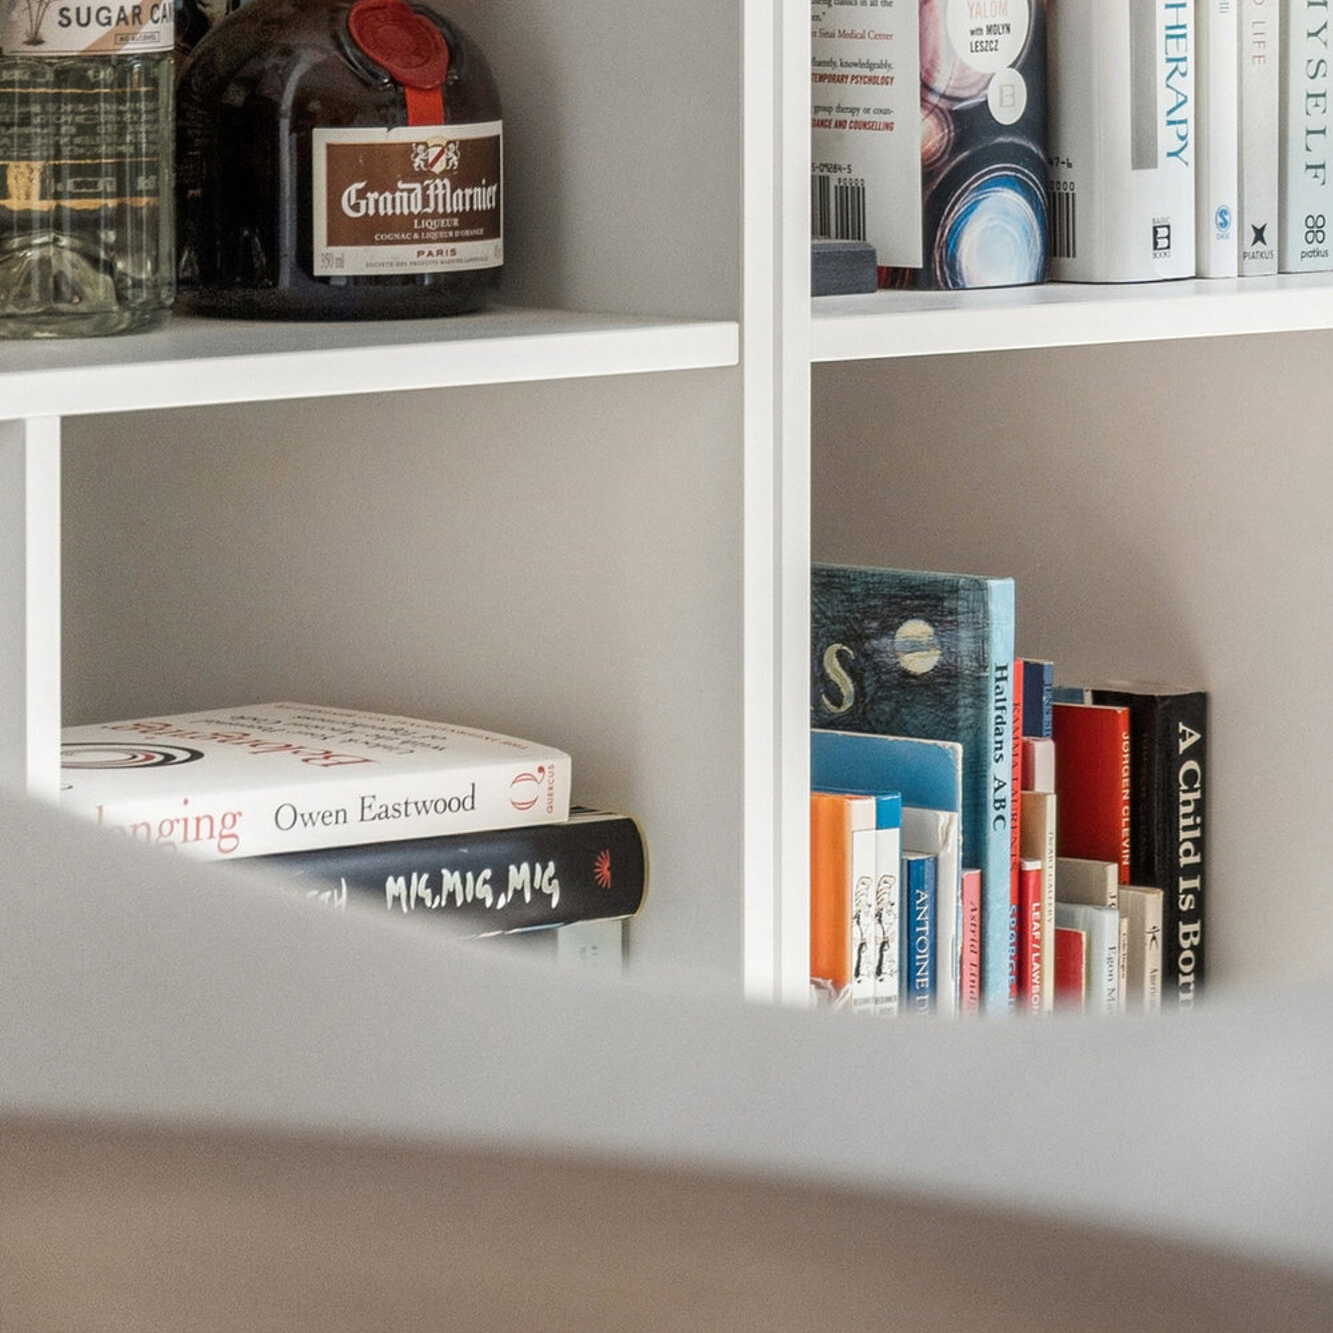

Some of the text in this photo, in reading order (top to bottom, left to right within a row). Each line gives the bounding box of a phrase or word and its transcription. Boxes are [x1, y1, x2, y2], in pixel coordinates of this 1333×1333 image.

[57, 4, 144, 29] SUGAR
[966, 0, 1009, 21] YALOM
[837, 29, 894, 42] Medical Center
[969, 39, 1001, 54] LESZCZ
[1250, 20, 1267, 66] LIFE
[850, 72, 895, 86] PSYCHOLOGY
[848, 119, 895, 133] COUNSELLING
[340, 176, 499, 218] Grand Marnier
[374, 229, 454, 242] COGNAC LIQUEUR
[413, 217, 460, 231] LIQUEUR
[416, 247, 458, 259] PARIS
[991, 661, 1009, 832] Halfdans ABC
[1011, 702, 1021, 763] KAMMA
[274, 782, 477, 832] Owen Eastwood
[546, 763, 556, 814] QUERCUS
[1120, 804, 1131, 867] CLEVIN
[1177, 722, 1202, 1012] A Child Is Born
[968, 901, 979, 955] Astrid
[1031, 902, 1041, 936] LEAF
[913, 888, 929, 992] ANTOINE
[1107, 946, 1117, 983] Egon
